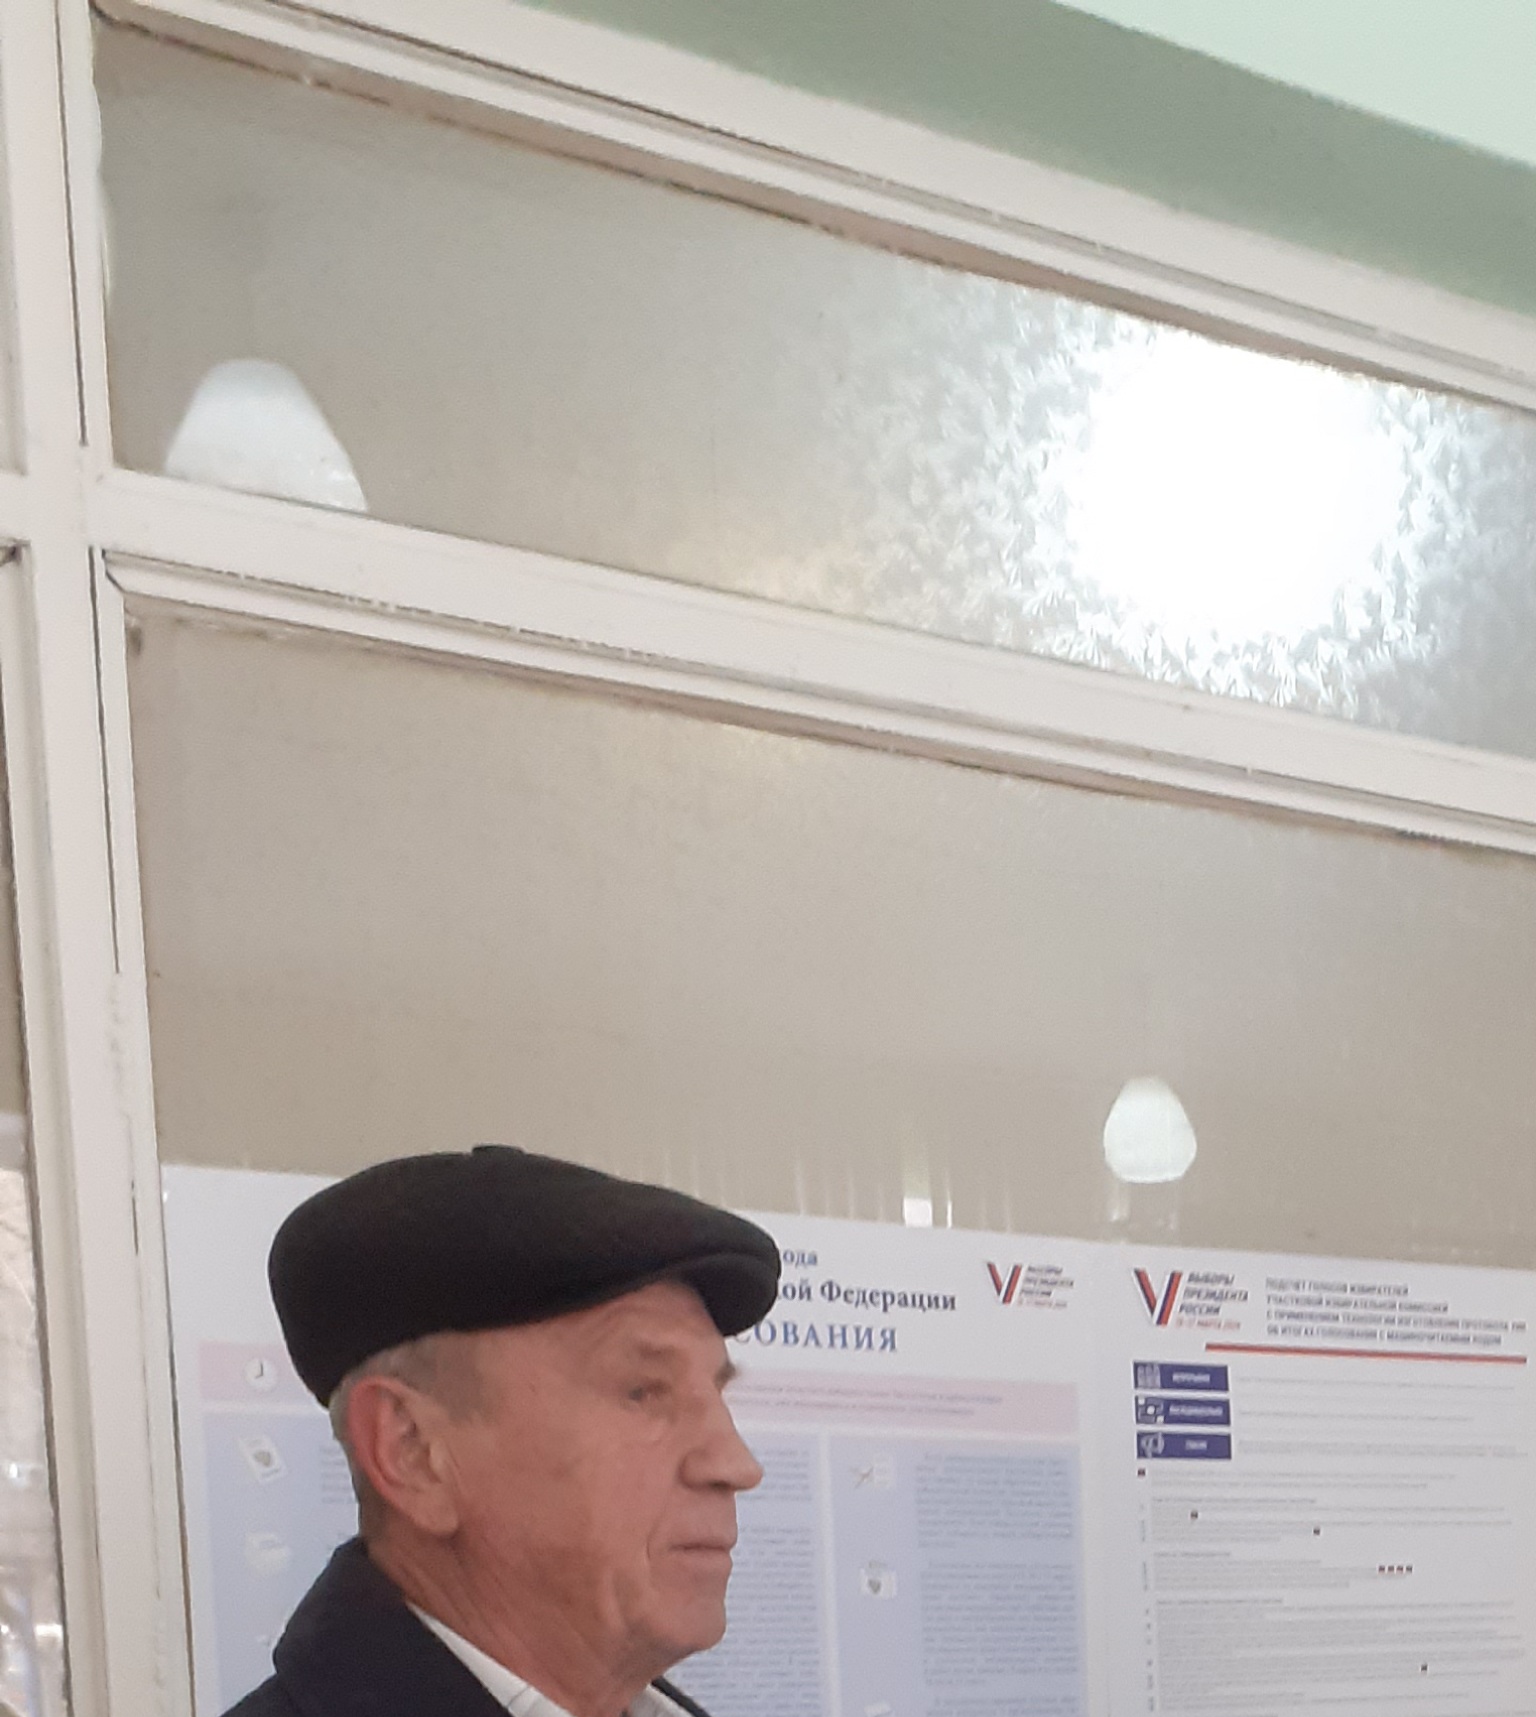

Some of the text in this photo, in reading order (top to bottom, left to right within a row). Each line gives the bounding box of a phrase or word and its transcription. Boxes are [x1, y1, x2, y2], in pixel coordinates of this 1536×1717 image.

[781, 1249, 818, 1268] ода
[1188, 1272, 1235, 1285] ВЫБОРЫ
[819, 1279, 957, 1313] Федерации
[1183, 1286, 1249, 1301] ПРЕЗИДЕНТА
[1178, 1302, 1221, 1315] РОССИИ
